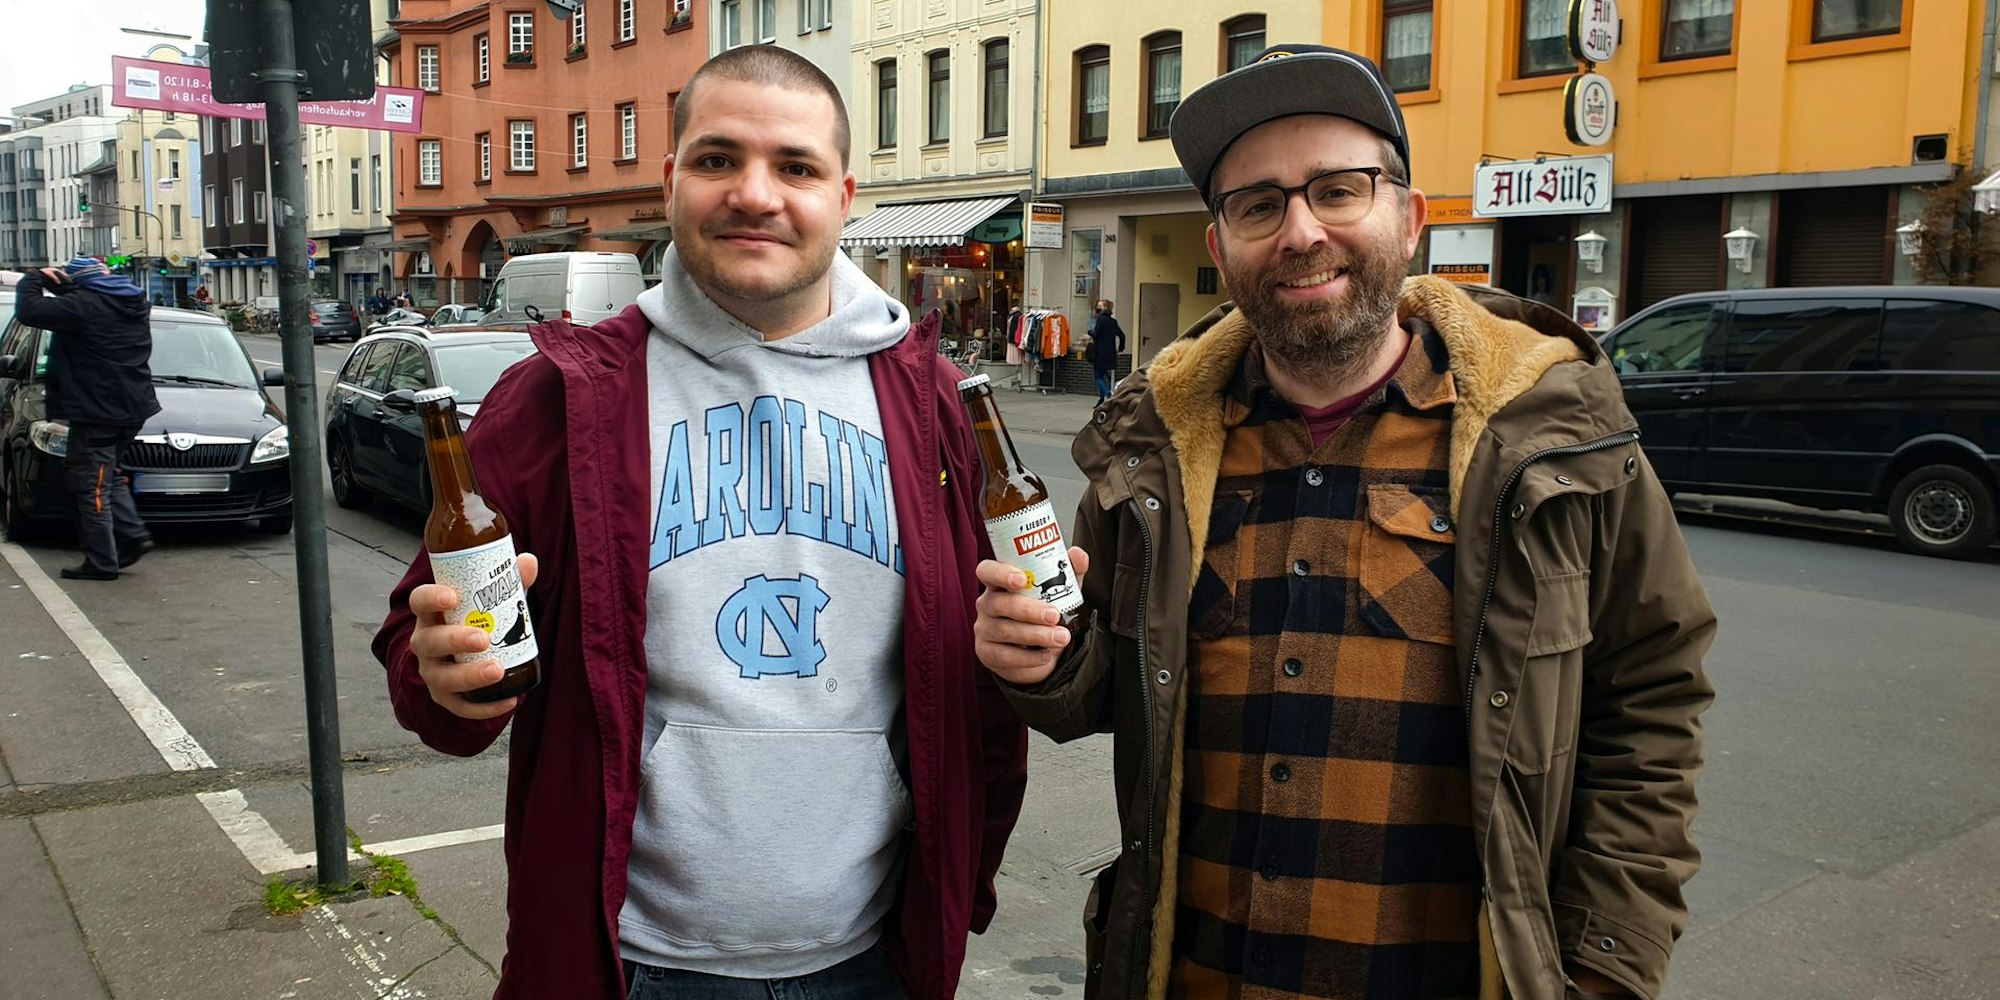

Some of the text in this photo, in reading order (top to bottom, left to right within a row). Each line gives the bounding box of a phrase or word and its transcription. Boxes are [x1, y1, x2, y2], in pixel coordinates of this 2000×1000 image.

[1587, 28, 1612, 56] Sülz
[1487, 165, 1598, 208] Alt Sülz
[1448, 208, 1473, 218] TREN
[1436, 265, 1484, 273] FRISEUR
[648, 395, 906, 578] AROLIN
[1025, 516, 1048, 531] LIEBER
[1019, 524, 1060, 551] WALDI
[488, 558, 512, 580] LIEBER
[474, 566, 520, 612] WAL
[469, 617, 488, 625] MAUL
